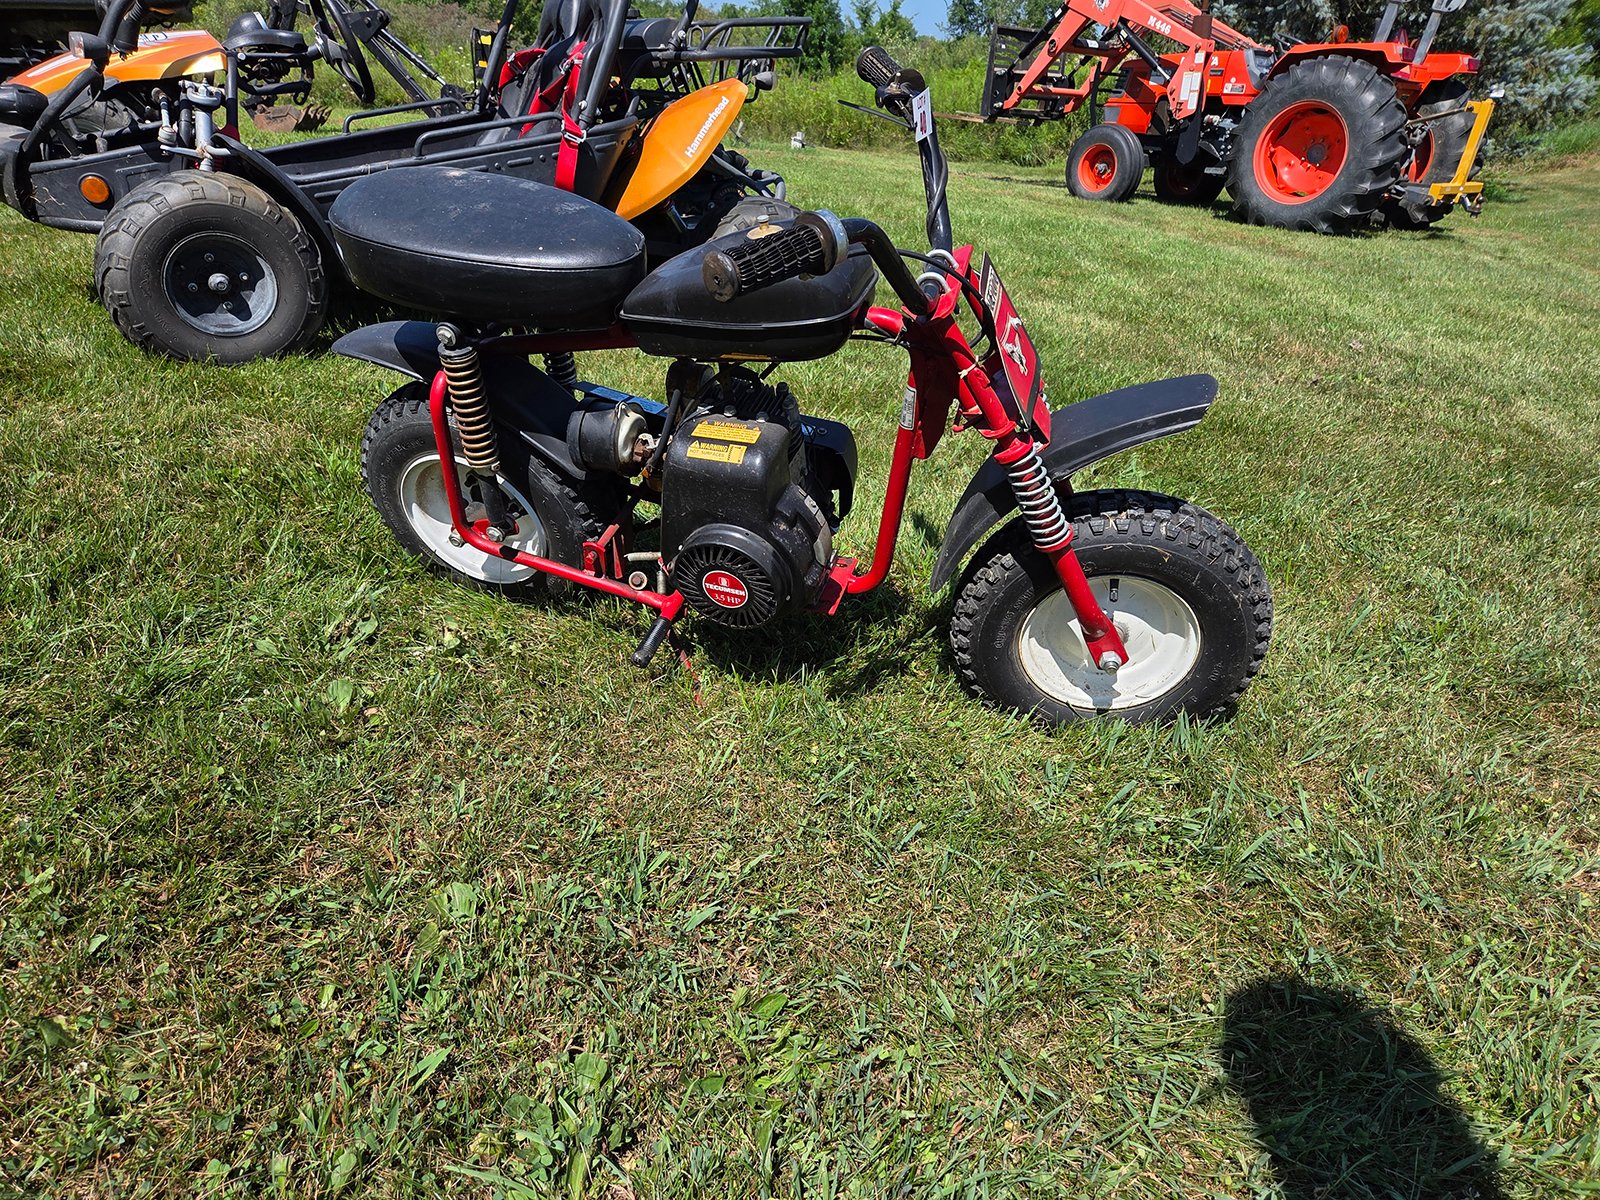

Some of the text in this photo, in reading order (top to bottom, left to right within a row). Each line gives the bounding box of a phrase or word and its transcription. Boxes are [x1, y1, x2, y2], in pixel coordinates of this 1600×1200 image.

[1147, 15, 1172, 35] M446
[684, 95, 730, 158] Hammerhead
[714, 421, 748, 430] WARNING
[700, 442, 729, 453] WARNING
[704, 582, 746, 597] TECUMSEH
[727, 595, 741, 605] HP
